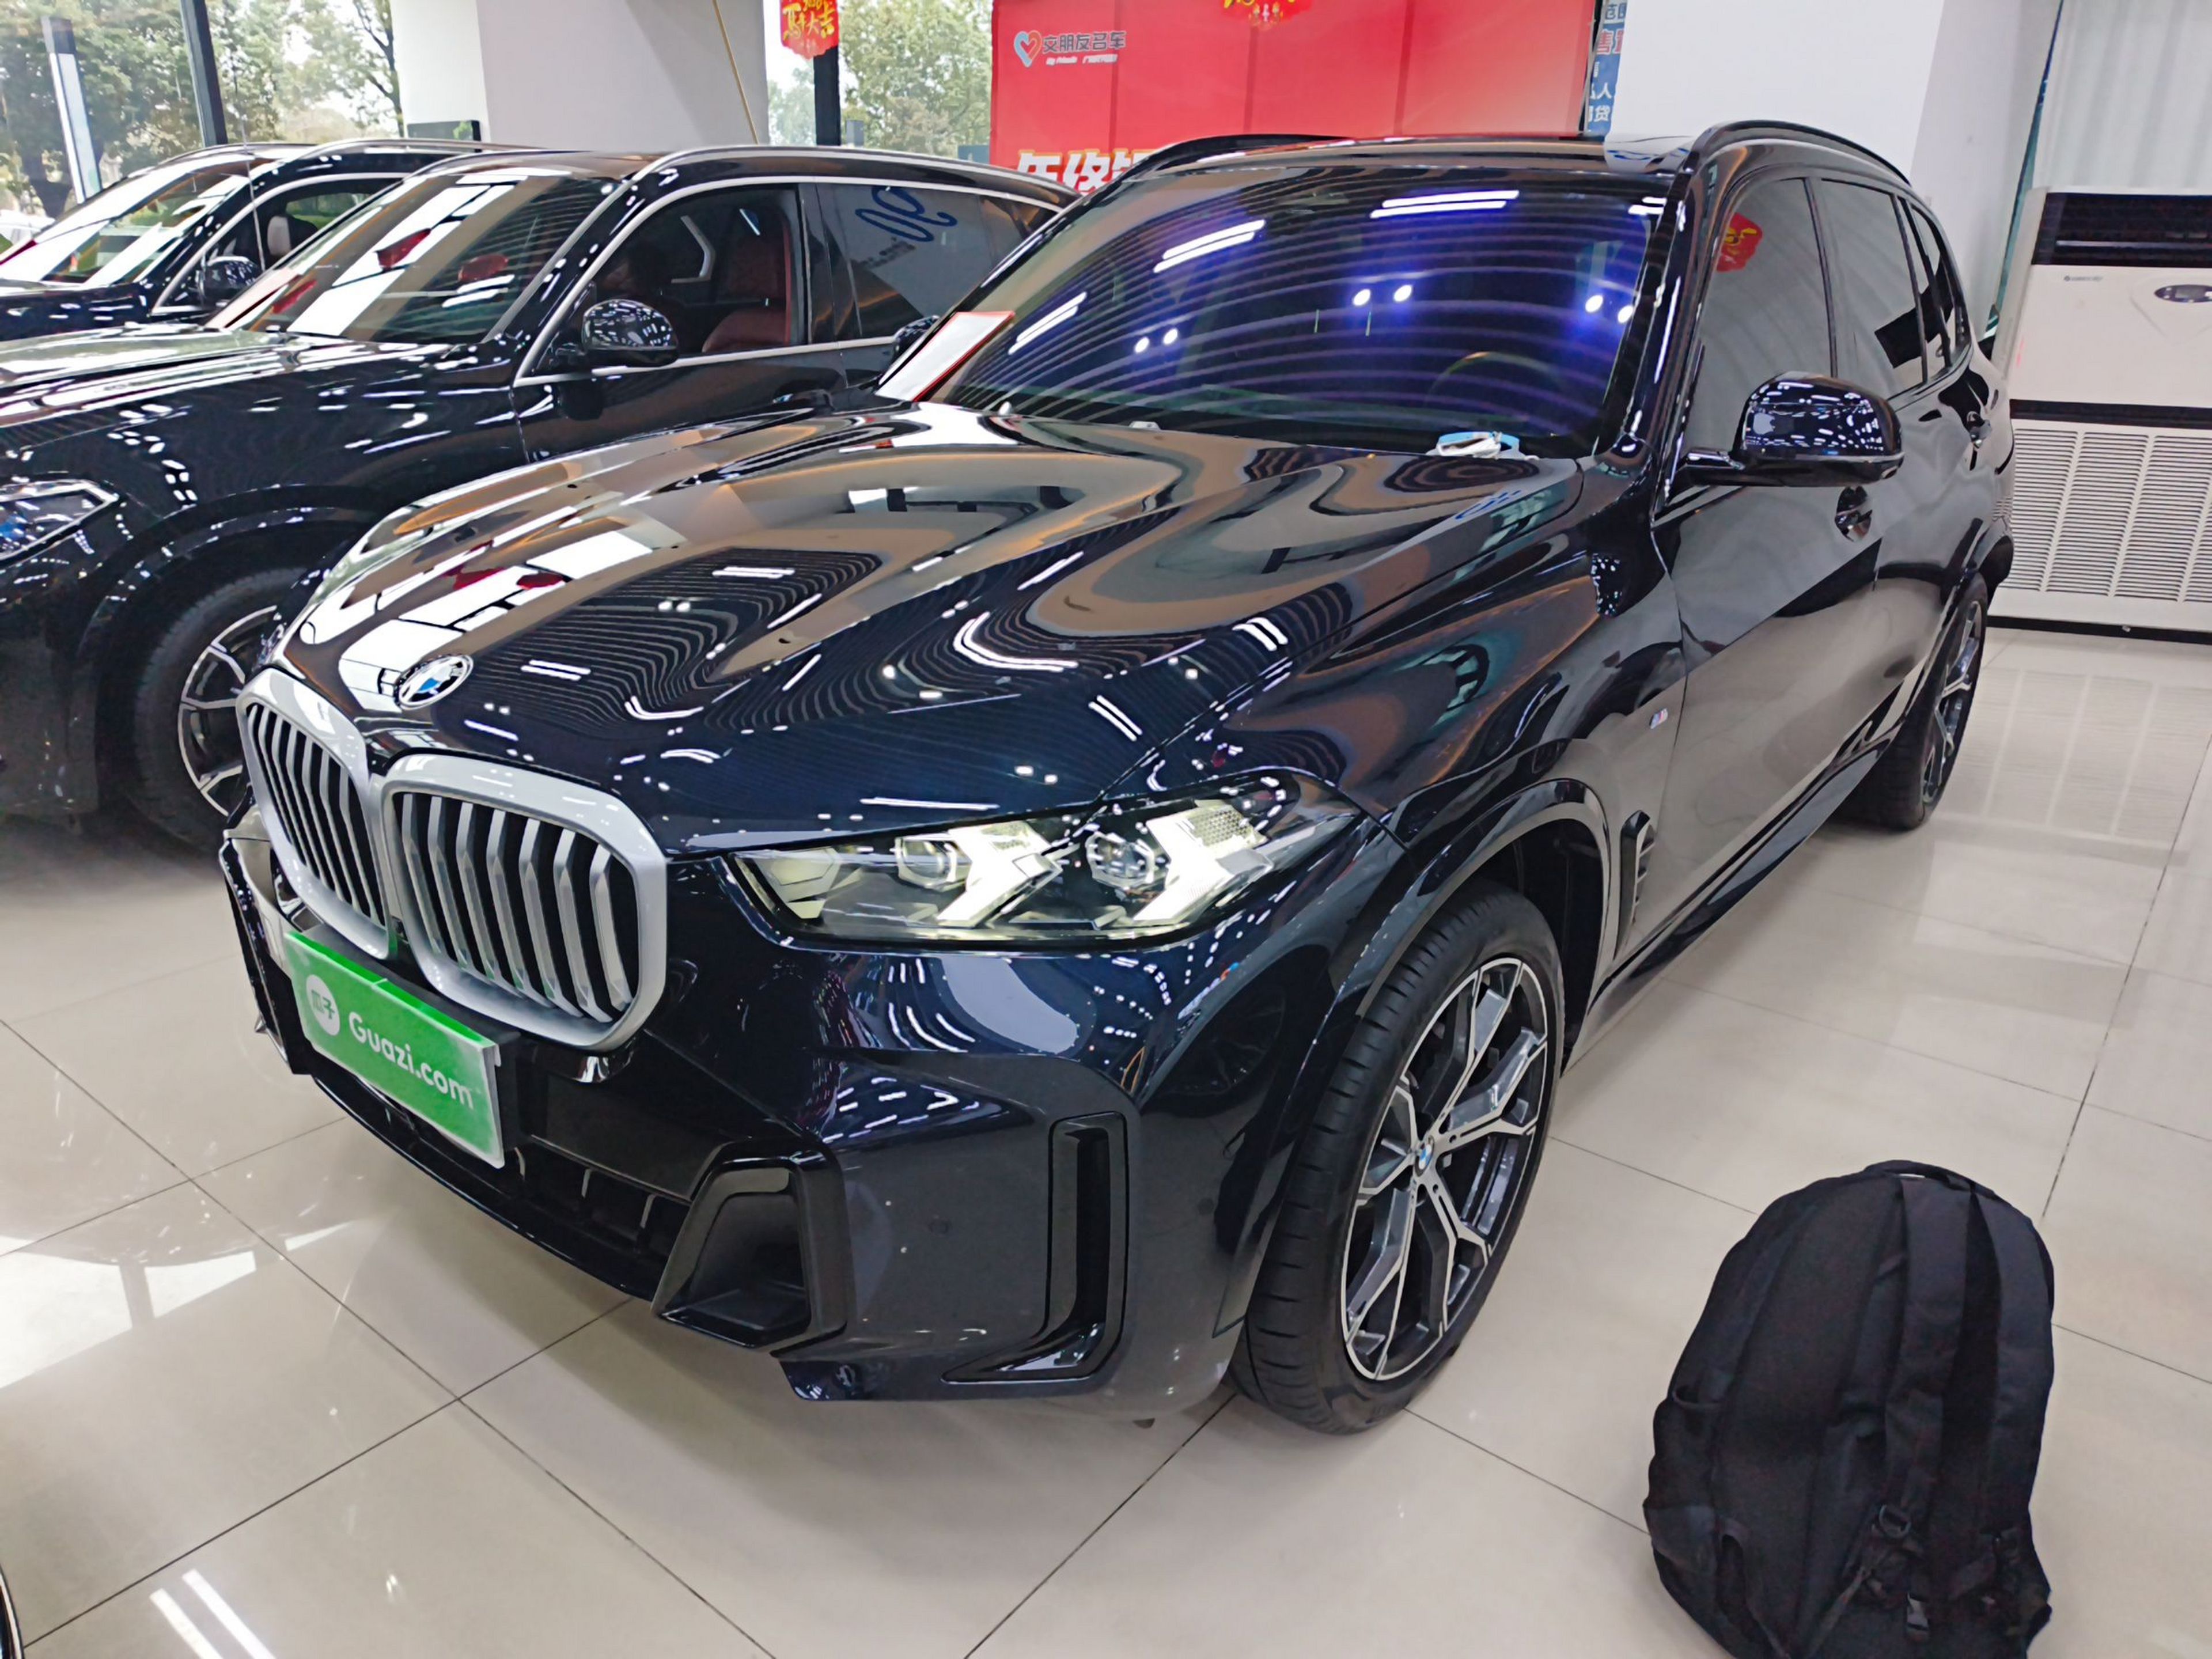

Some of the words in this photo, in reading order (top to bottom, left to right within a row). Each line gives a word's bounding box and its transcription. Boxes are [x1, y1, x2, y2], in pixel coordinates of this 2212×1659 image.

[1043, 31, 1126, 54] 交朋友名车
[349, 1012, 474, 1109] Guazi.com
